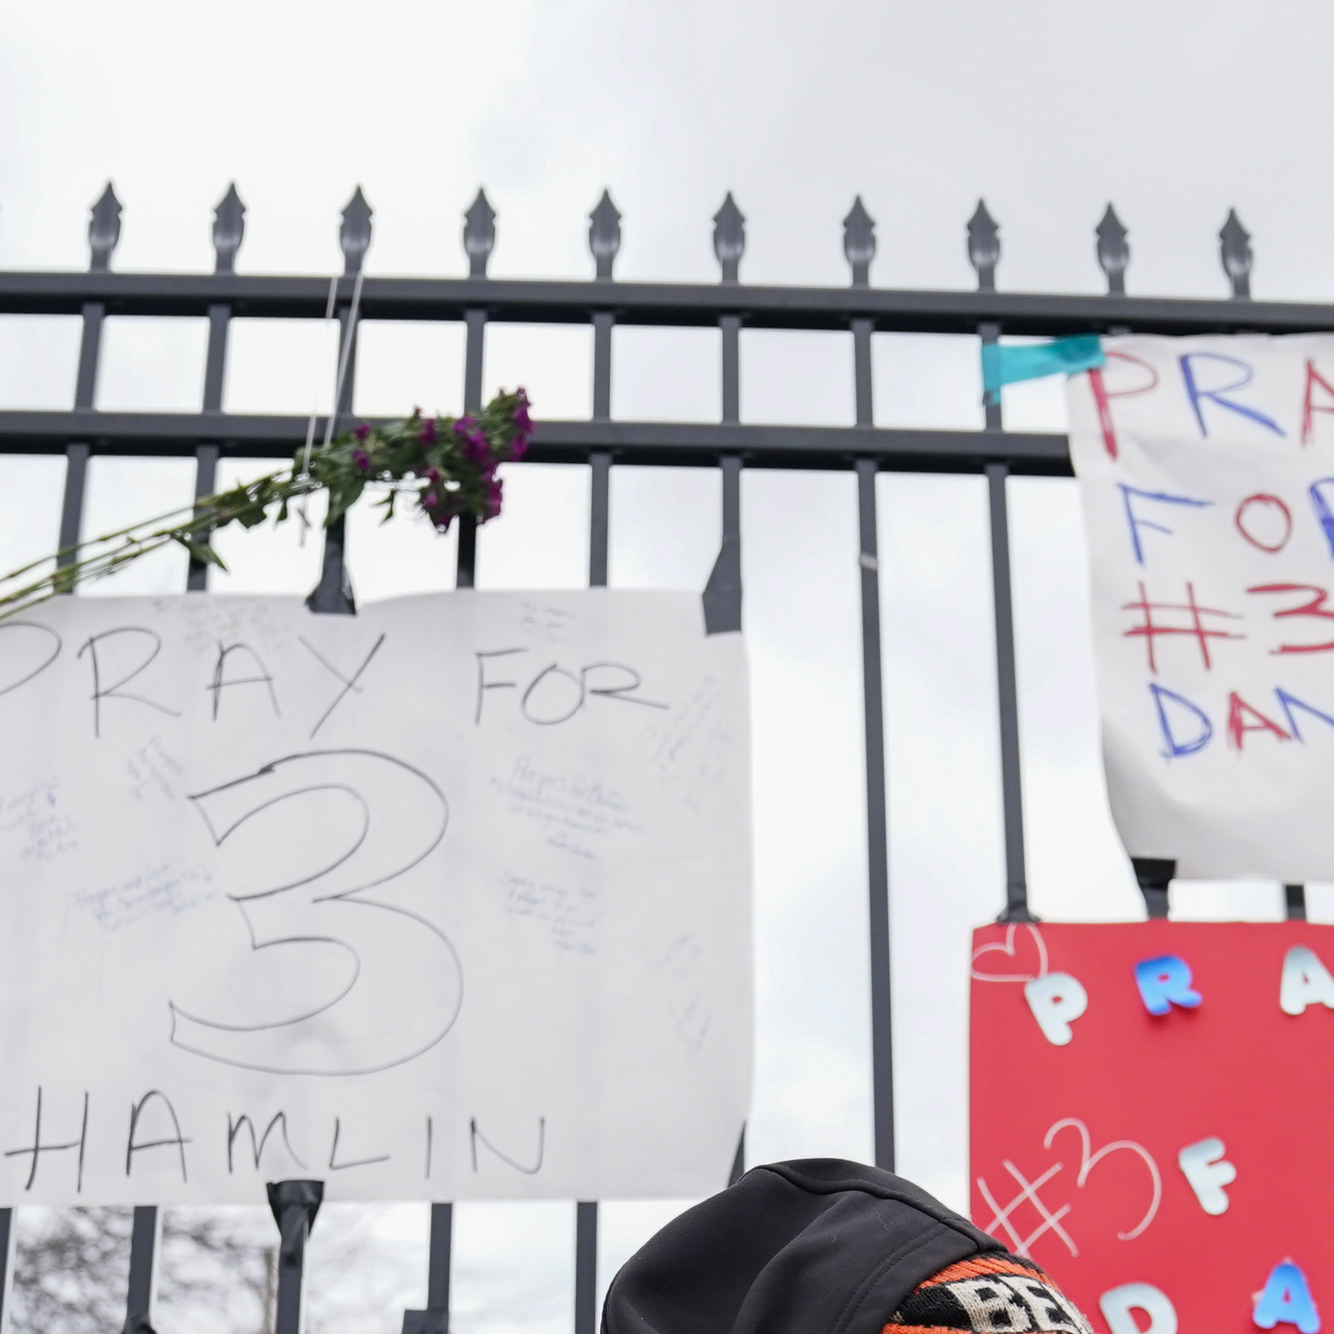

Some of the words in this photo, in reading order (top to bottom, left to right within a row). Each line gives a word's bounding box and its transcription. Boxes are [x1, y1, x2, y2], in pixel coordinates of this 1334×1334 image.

[473, 645, 670, 727] FOR
[167, 748, 465, 1078] 3
[2, 1084, 548, 1195] HAMLIN
[976, 1118, 1163, 1259] #3
